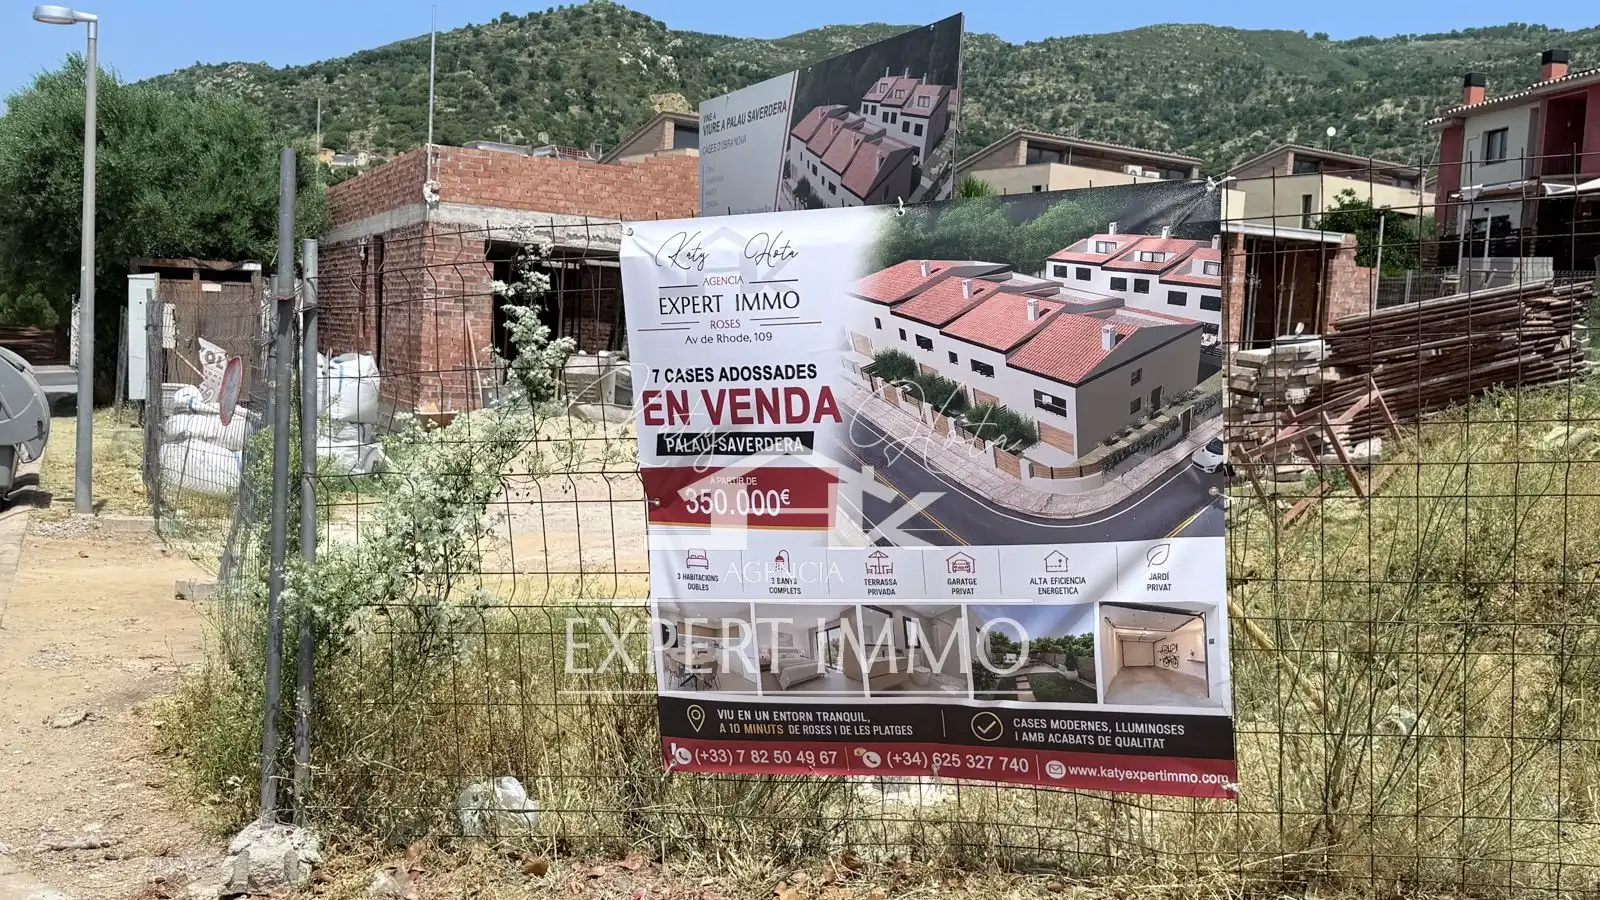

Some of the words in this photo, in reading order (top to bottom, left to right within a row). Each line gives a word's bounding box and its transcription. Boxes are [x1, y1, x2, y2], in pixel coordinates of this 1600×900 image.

[703, 121, 721, 136] VIURE
[721, 119, 726, 132] A
[726, 112, 746, 130] PALAU
[747, 100, 787, 123] SAVERDERA
[655, 231, 709, 271] Katy
[703, 276, 744, 287] AGENCIA
[659, 295, 723, 315] EXPERT
[736, 290, 800, 312] IMMO
[710, 319, 741, 330] ROSES
[685, 335, 699, 345] Av
[700, 334, 713, 345] de
[716, 333, 752, 343] Rhode,
[754, 332, 773, 342] 109
[652, 369, 660, 383] 7
[664, 367, 714, 383] CASES
[718, 363, 817, 382] ADOSSADES
[642, 389, 691, 426] EN
[701, 385, 843, 426] VENDA
[666, 436, 804, 453] PALAU-SAVERDERA
[716, 477, 745, 485] PARTIR
[746, 477, 758, 486] DE
[684, 487, 791, 517] 350.000€
[682, 573, 719, 582] HABITACIONS
[864, 578, 898, 586] TERRASSA
[947, 577, 978, 586] GARATGE
[1029, 577, 1048, 585] ALTA
[1050, 576, 1087, 585] EFICIENCIA
[1148, 571, 1170, 581] JARDÍ
[687, 582, 710, 591] DOBLES
[769, 586, 802, 595] COMPLETS
[867, 588, 896, 596] PRIVADA
[951, 587, 974, 596] PRIVAT
[1146, 583, 1172, 592] PRIVAT
[716, 708, 735, 721] VIU
[737, 709, 751, 721] EN
[754, 710, 770, 721] UN
[773, 711, 813, 722] ENTORN
[815, 711, 871, 723] TRANQUIL,
[719, 723, 727, 734] A
[728, 723, 741, 734] 10
[743, 723, 784, 735] MINUTS
[788, 725, 801, 735] DE
[802, 725, 832, 735] ROSES
[838, 725, 852, 735] DE
[854, 725, 871, 736] LES
[872, 725, 914, 736] PLATGES
[1013, 718, 1047, 729] CASES
[1050, 720, 1112, 732] MODERNES,
[1115, 723, 1185, 735] LLUMINOSES
[1022, 732, 1045, 743] AMB
[1048, 733, 1094, 745] ACABATS
[1098, 735, 1112, 746] DE
[1115, 736, 1165, 749] QUALITAT
[695, 749, 733, 767] (+33)
[736, 750, 745, 763] 7
[751, 750, 769, 763] 82
[774, 750, 792, 764] 50
[796, 750, 815, 765] 49
[819, 751, 837, 764] 67
[887, 751, 928, 768] (+34)
[932, 752, 961, 768] 625
[966, 754, 993, 769] 327
[999, 756, 1029, 773] 740
